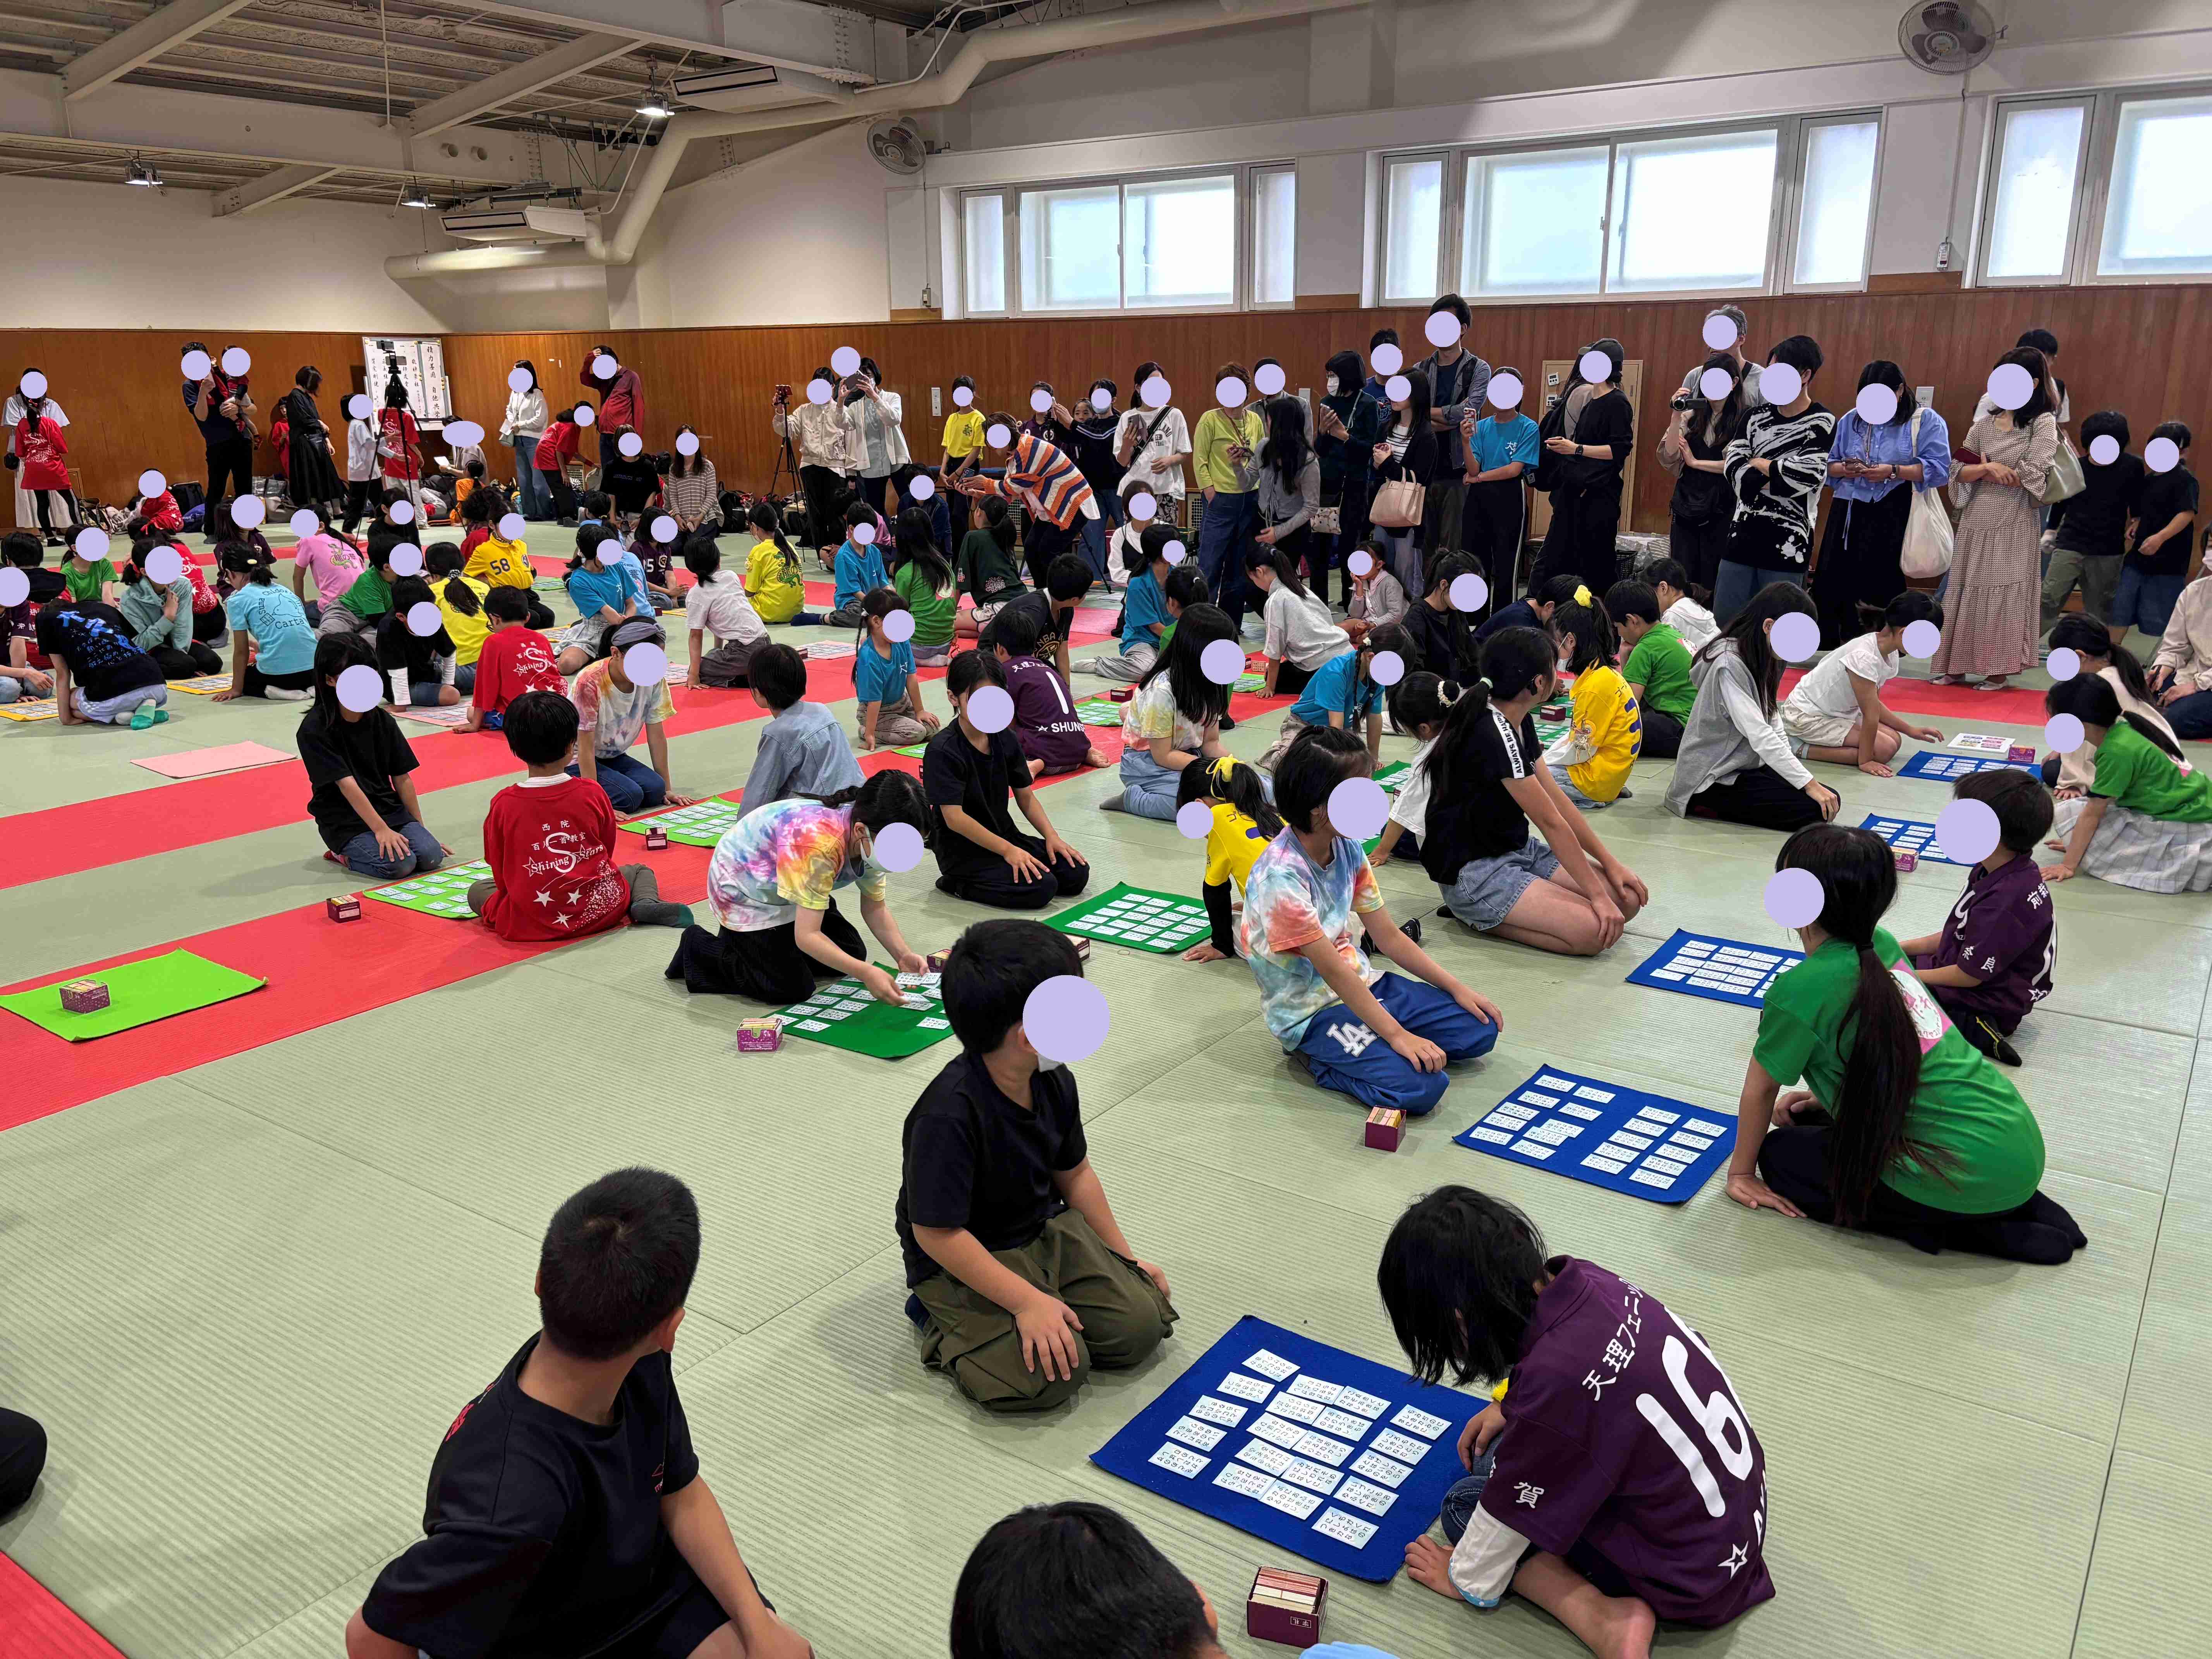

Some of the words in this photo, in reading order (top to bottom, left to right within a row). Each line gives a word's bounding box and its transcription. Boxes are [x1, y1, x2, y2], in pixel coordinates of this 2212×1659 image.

[489, 558, 510, 575] 58
[275, 617, 304, 629] Carta
[1037, 632, 1056, 646] NBA
[1505, 732, 1513, 743] BE
[1509, 743, 1523, 774] ALWAYS
[531, 856, 570, 873] Shining
[579, 844, 604, 858] Stars
[1326, 1022, 1378, 1058] LA
[1635, 1306, 1753, 1518] 16
